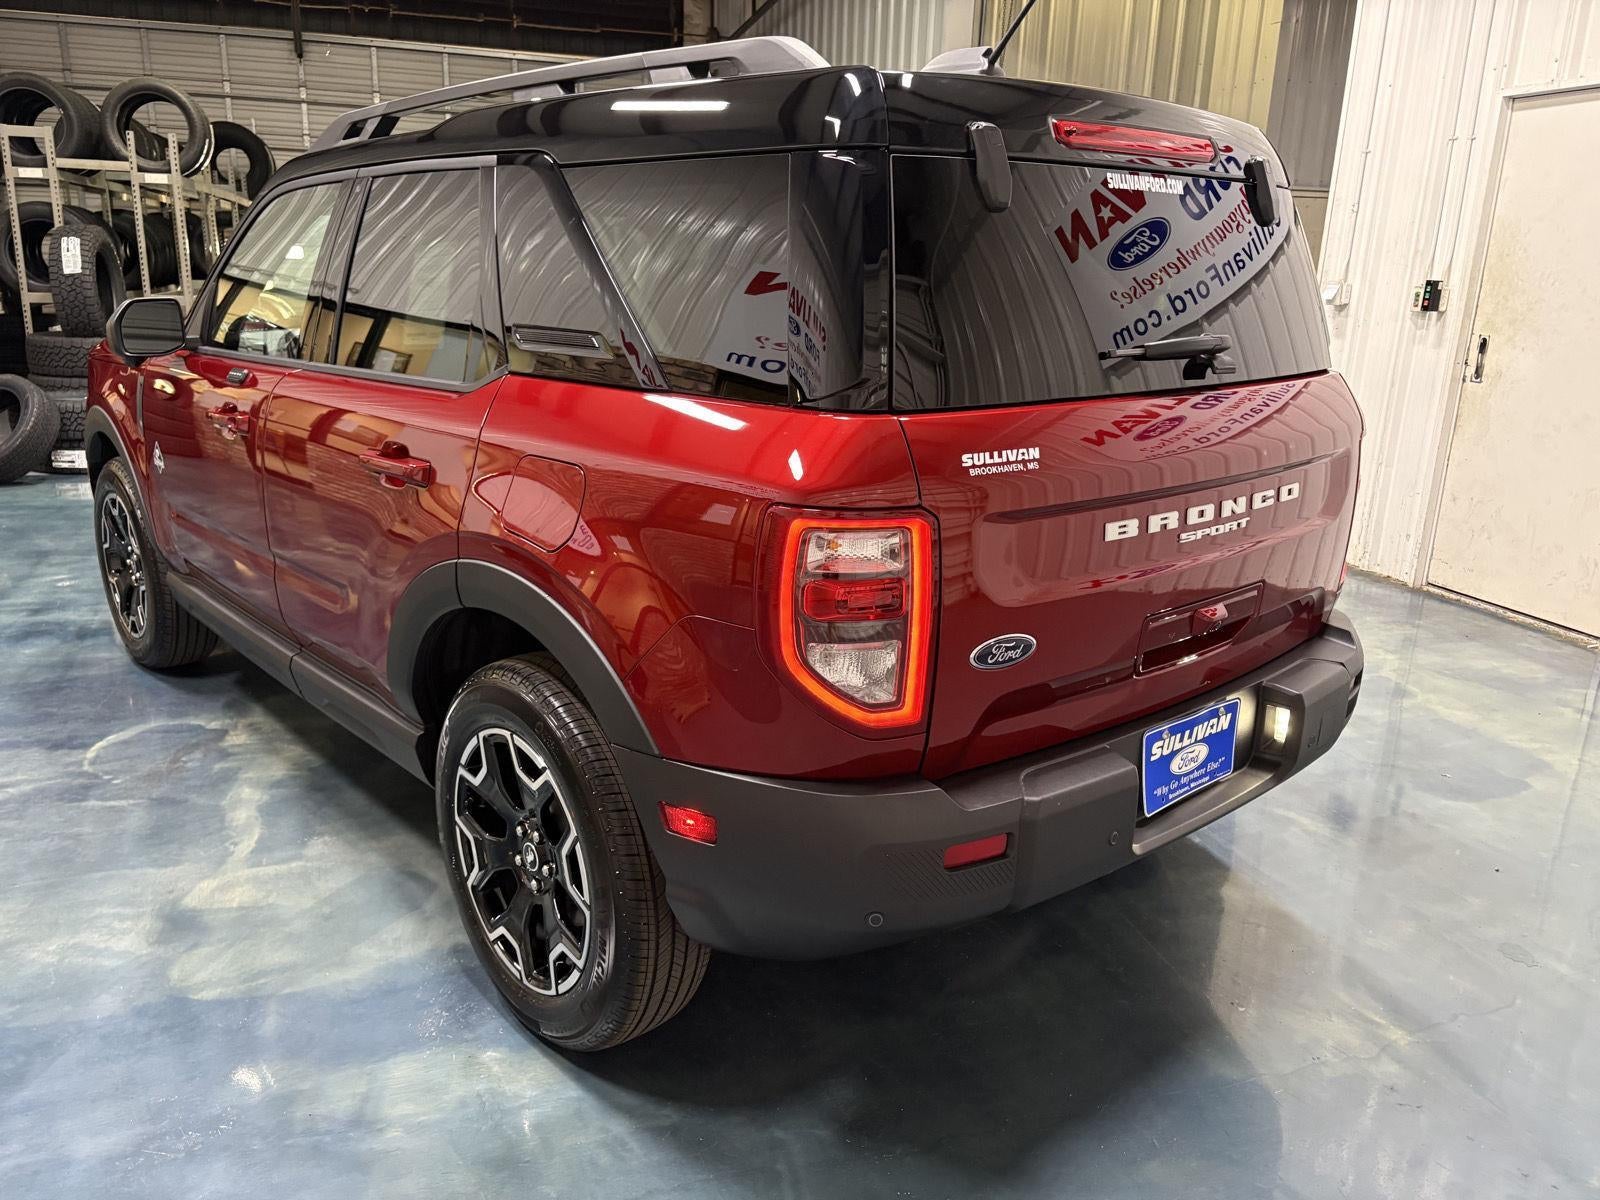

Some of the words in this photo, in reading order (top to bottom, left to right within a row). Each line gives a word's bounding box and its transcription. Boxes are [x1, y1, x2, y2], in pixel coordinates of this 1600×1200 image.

[1106, 172, 1184, 195] SULLIVANFORD.COM
[961, 447, 1040, 467] SULLIVAN
[969, 463, 1027, 477] BROOKHAVEN,
[1027, 461, 1040, 470] MS
[1105, 482, 1300, 542] BRONCO
[1178, 517, 1251, 543] SPORT
[1150, 712, 1232, 762] SULLIVAN
